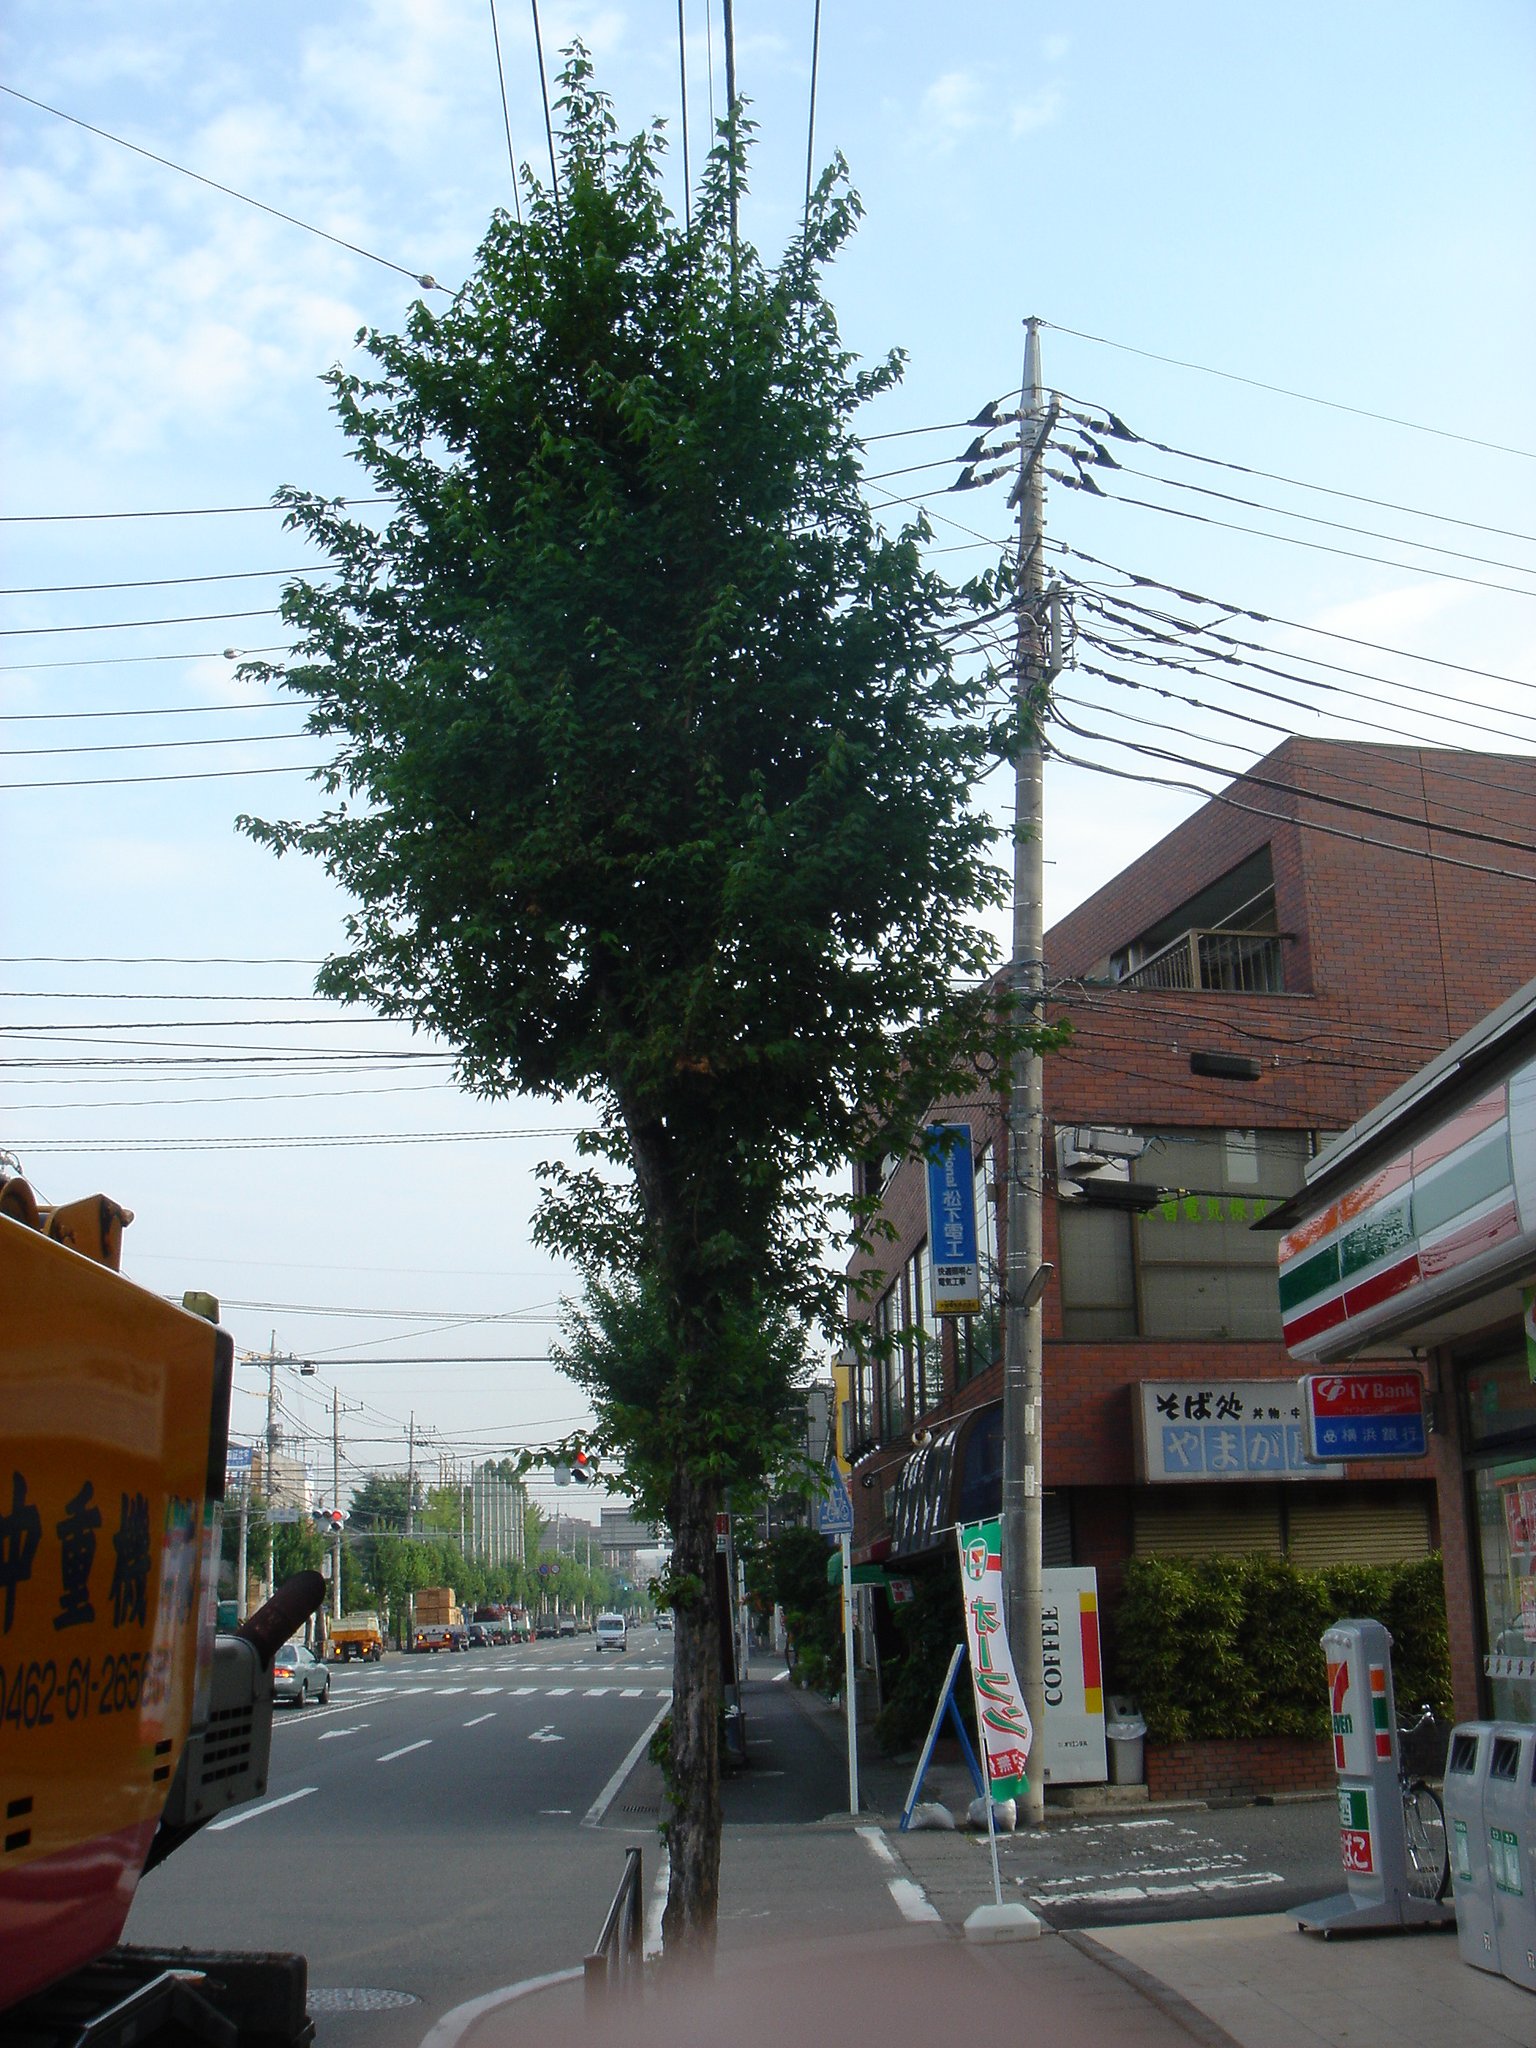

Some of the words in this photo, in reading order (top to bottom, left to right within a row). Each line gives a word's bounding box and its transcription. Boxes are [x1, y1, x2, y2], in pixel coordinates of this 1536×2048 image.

[943, 1190, 964, 1258] 松下電工
[1156, 1391, 1244, 1421] そば処
[1350, 1383, 1369, 1400] IY
[1373, 1382, 1416, 1399] Bank
[1168, 1431, 1303, 1470] やまが
[1342, 1426, 1417, 1442] 横浜銀行
[1041, 1605, 1063, 1707] COFFEE
